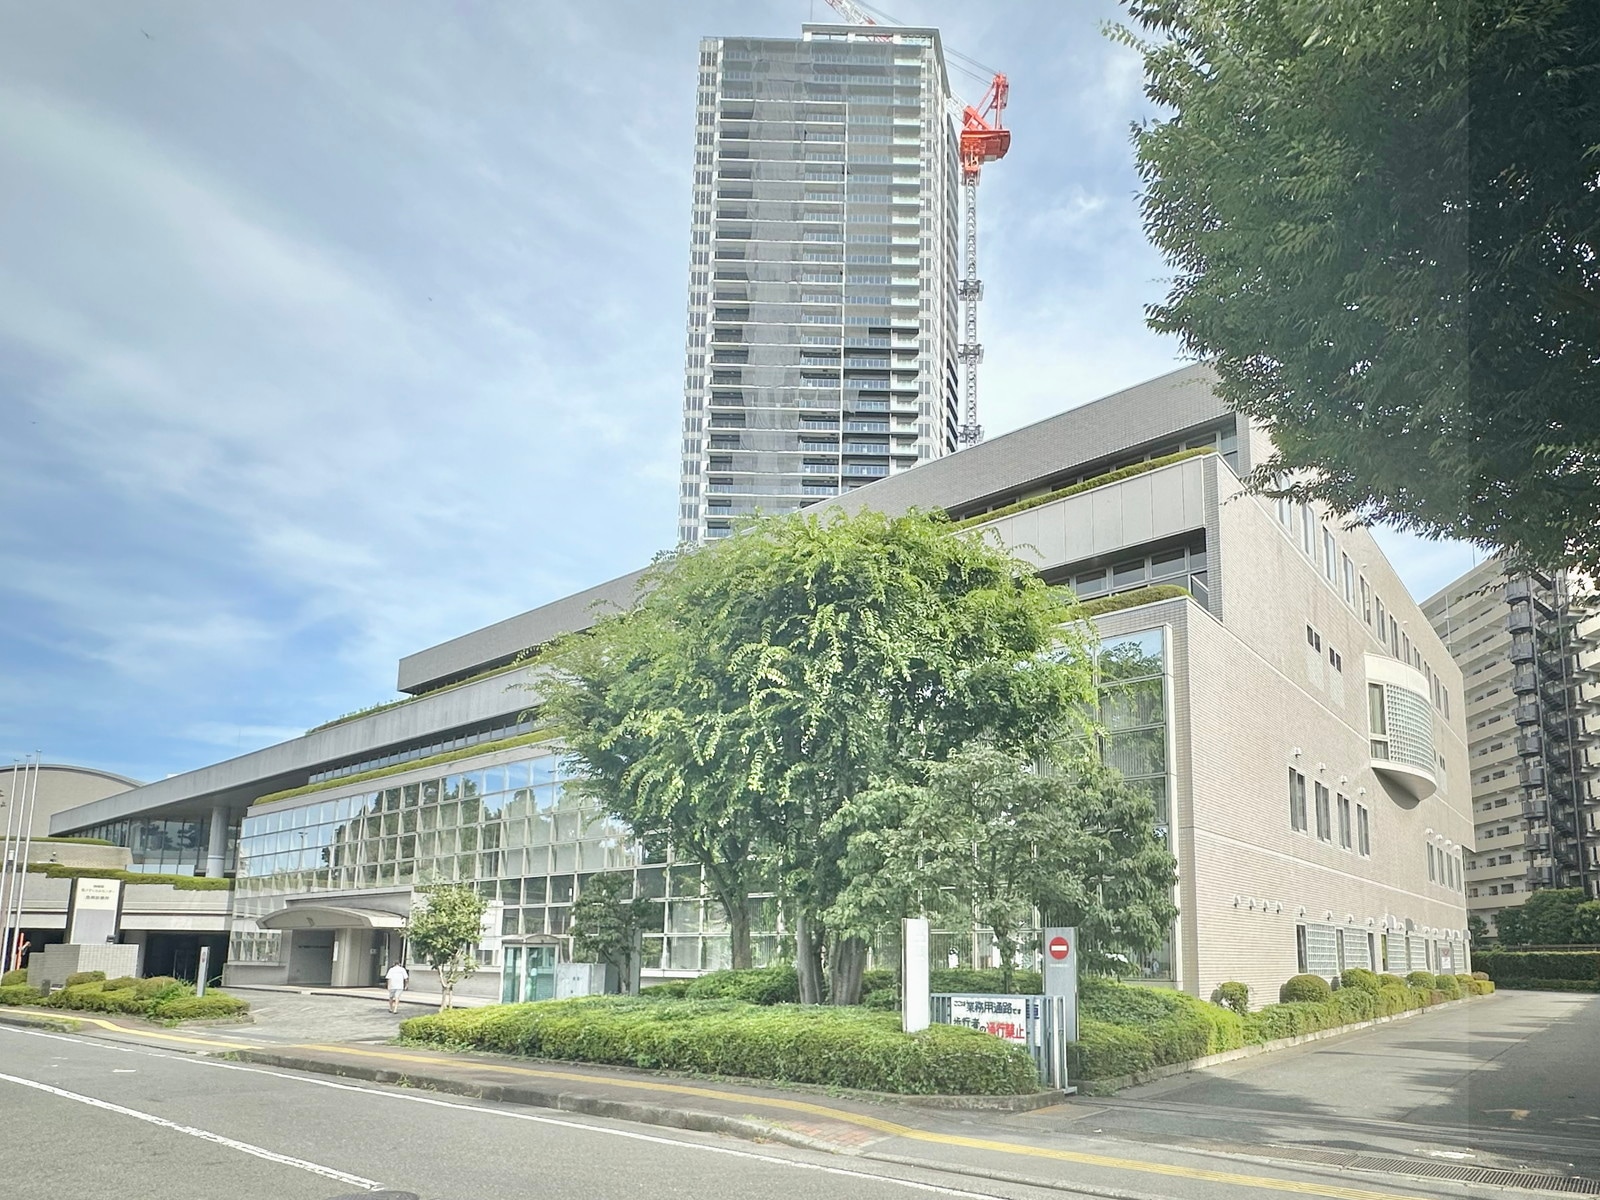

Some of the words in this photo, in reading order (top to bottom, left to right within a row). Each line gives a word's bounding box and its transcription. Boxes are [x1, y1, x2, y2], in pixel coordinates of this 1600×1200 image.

[953, 1000, 1022, 1015] ここは業務用通路です
